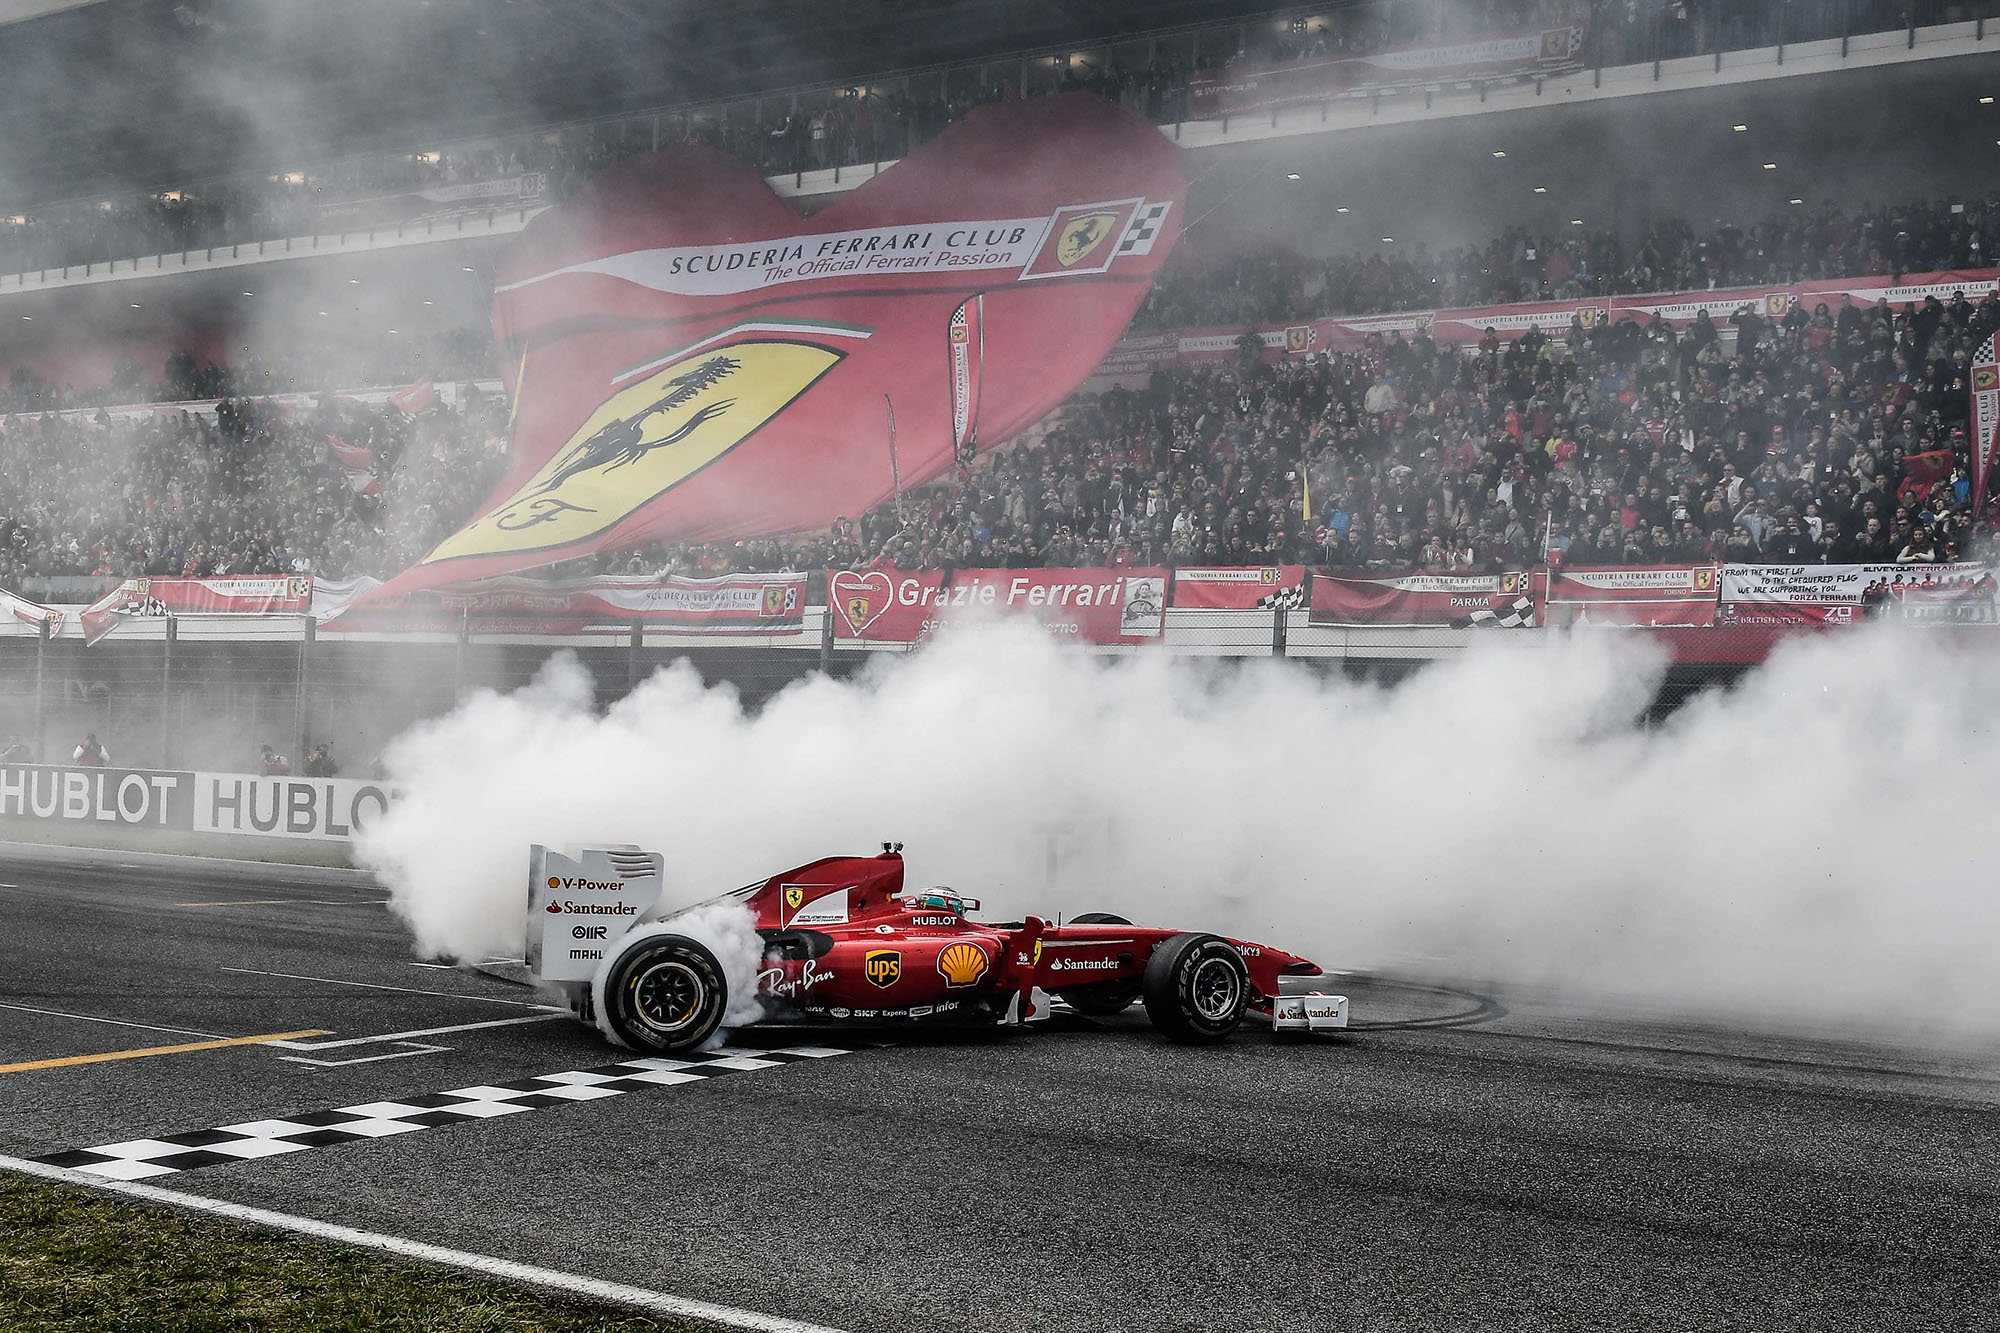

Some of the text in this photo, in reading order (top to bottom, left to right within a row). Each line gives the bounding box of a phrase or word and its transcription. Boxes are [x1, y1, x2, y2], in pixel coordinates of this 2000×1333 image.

[670, 228, 1026, 274] SCUDERIA FERRARI CLUB
[764, 249, 1012, 282] The Official Ferrari Passion
[1884, 288, 1927, 296] SCUDERIA
[1930, 284, 1966, 292] FERRARI
[1475, 317, 1512, 325] SCUDERIA
[1262, 336, 1282, 344] LUB
[1980, 394, 1989, 422] CLUB
[954, 402, 962, 435] CUDERIA
[1750, 568, 1762, 576] THE
[1766, 568, 1788, 576] FIRST
[1788, 576, 1834, 584] CHEQUERED
[1837, 574, 1858, 582] FLAG
[646, 592, 757, 601] SCUDERIA FERRARI CLUB
[899, 577, 1124, 607] Grazie Ferrari
[1770, 586, 1818, 594] SUPPORTING
[1450, 598, 1490, 606] PARMA
[1823, 606, 1852, 617] 70
[0, 768, 178, 825] HUBLOT
[212, 779, 389, 837] HUBLO
[562, 878, 625, 891] V-Power
[564, 900, 638, 916] Santander
[912, 916, 958, 926] HUBLOT
[570, 950, 605, 960] MAHL
[1064, 957, 1120, 970] Santander
[868, 960, 898, 982] ups
[1178, 948, 1202, 998] ZERO
[936, 1001, 960, 1012] infor
[1286, 1006, 1339, 1020] Santander
